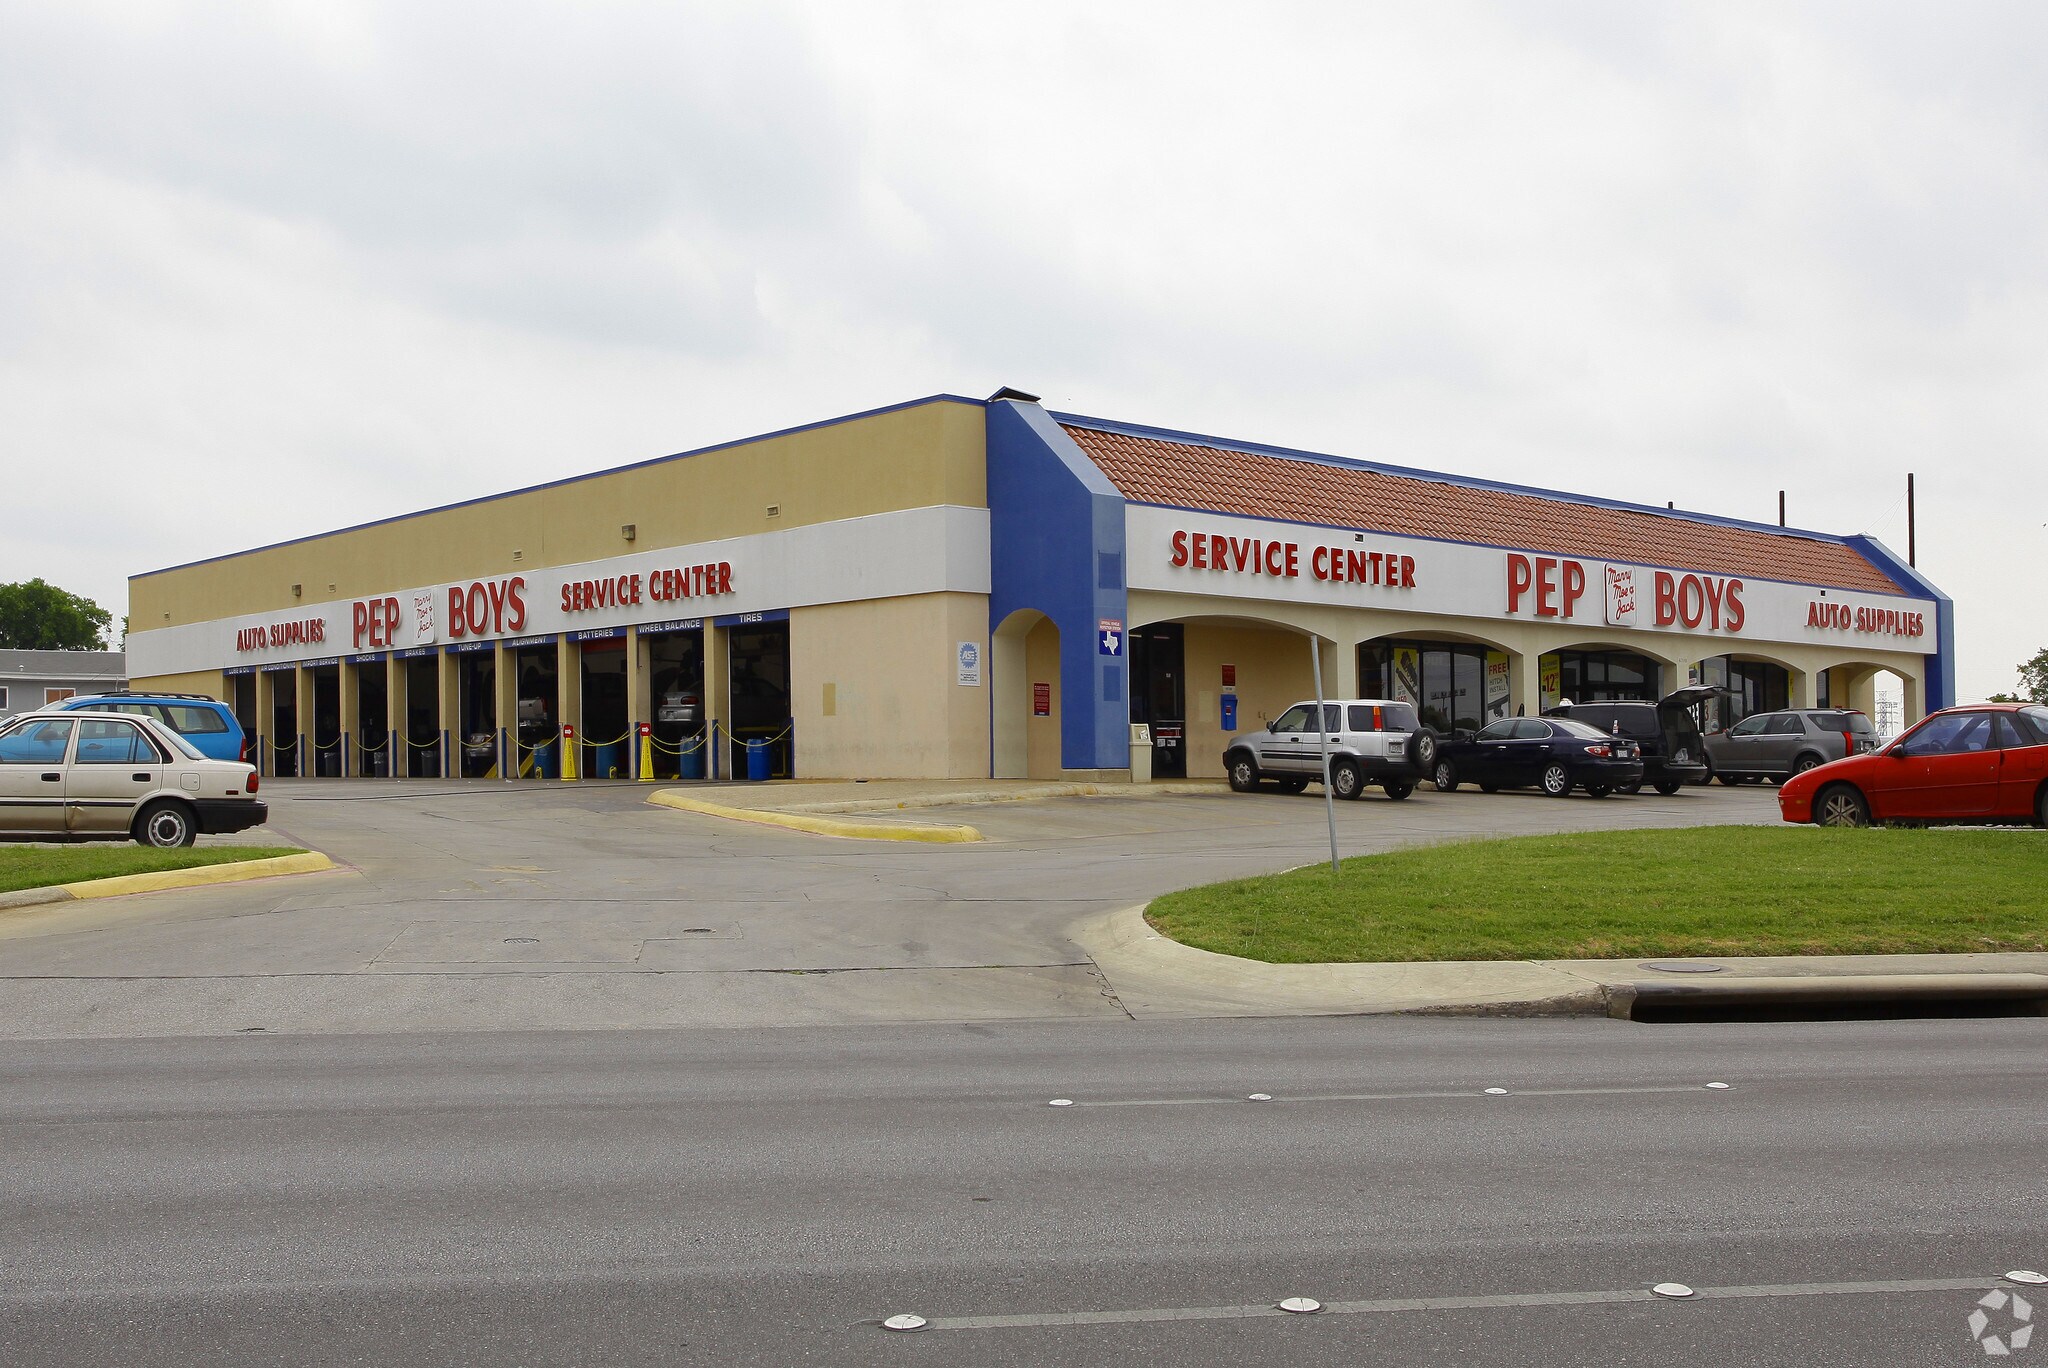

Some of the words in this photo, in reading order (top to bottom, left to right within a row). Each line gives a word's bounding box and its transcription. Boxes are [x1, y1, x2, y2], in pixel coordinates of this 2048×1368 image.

[1171, 530, 1299, 577] SERVICE
[1311, 545, 1417, 588] CENTER
[1607, 567, 1632, 585] Manny
[560, 574, 641, 613] SERVICE
[649, 561, 734, 601] CENTER
[1507, 553, 1586, 618] PEP
[1654, 570, 1746, 632] BOYS
[1613, 583, 1628, 600] Moe
[352, 596, 401, 649] PEP
[448, 576, 527, 638] BOYS
[1616, 597, 1636, 620] Jack
[739, 612, 763, 623] TIRES
[1807, 601, 1852, 630] AUTO
[1857, 606, 1924, 637] SUPPLIES
[417, 614, 434, 639] Jack
[638, 622, 663, 633] WHEEL
[664, 619, 701, 631] BALANCE
[236, 626, 268, 651] AUTO
[269, 617, 325, 648] SUPPLIES
[578, 629, 614, 640] BATTERIES
[458, 643, 482, 651] TUNE-UP
[512, 636, 547, 646] ALIGNMENT
[356, 654, 376, 662] SHOCKS
[405, 648, 426, 657] BRAKES
[962, 650, 975, 660] ASE
[319, 657, 338, 666] SERVICE
[1488, 663, 1507, 675] FREE
[1489, 677, 1503, 685] HITCH
[1489, 685, 1506, 693] INSTALL
